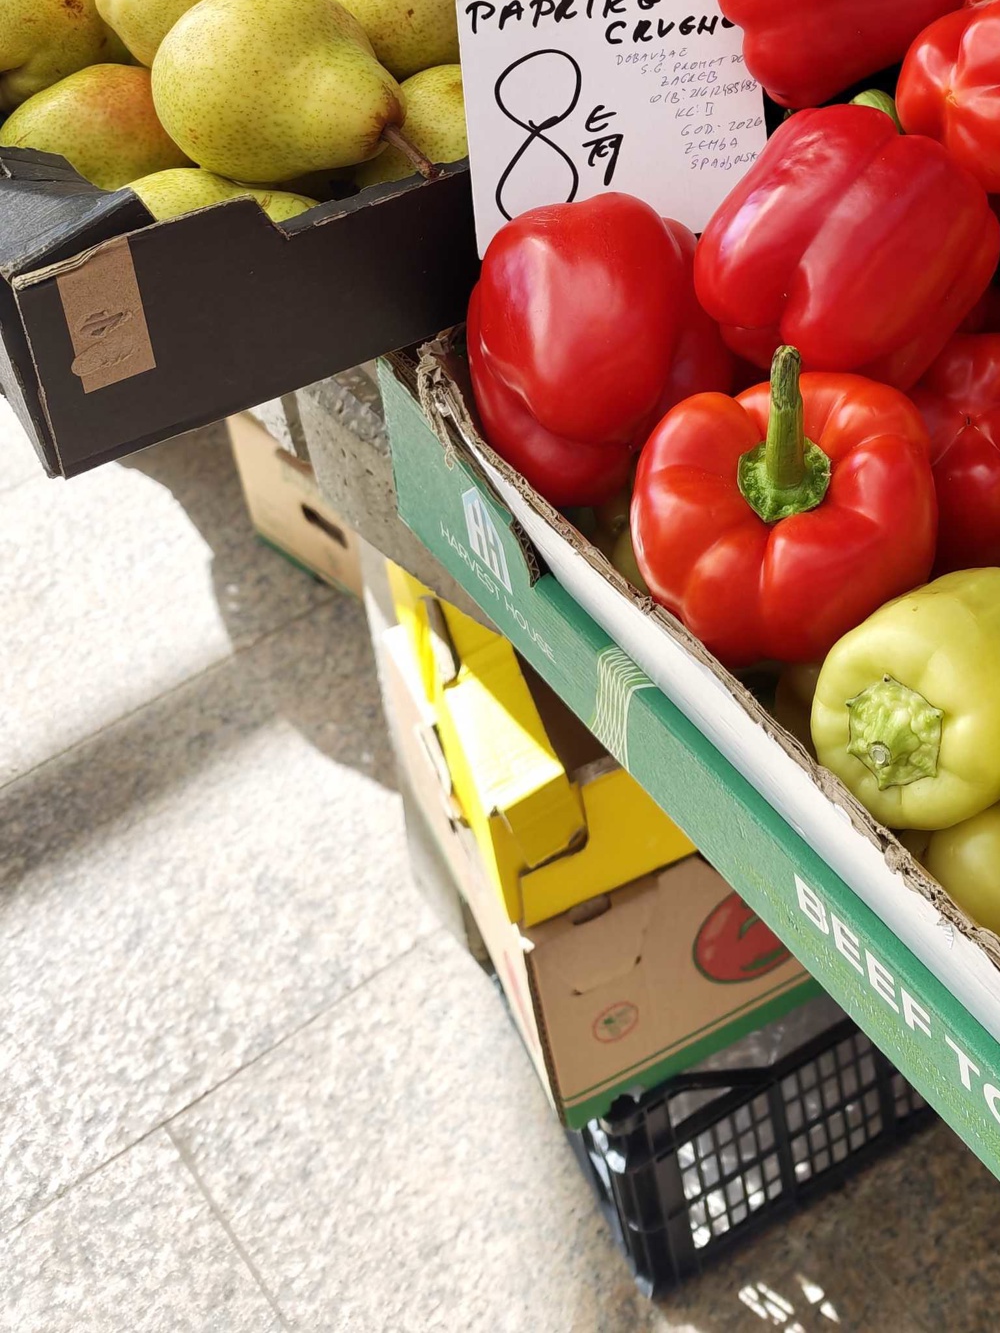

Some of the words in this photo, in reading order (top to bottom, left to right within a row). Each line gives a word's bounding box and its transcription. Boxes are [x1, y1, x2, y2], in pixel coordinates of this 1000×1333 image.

[494, 48, 582, 222] 8
[661, 71, 718, 87] ZAGREB
[439, 520, 501, 600] HARVEST
[503, 595, 557, 665] HOUSE
[793, 872, 933, 1039] BEEF
